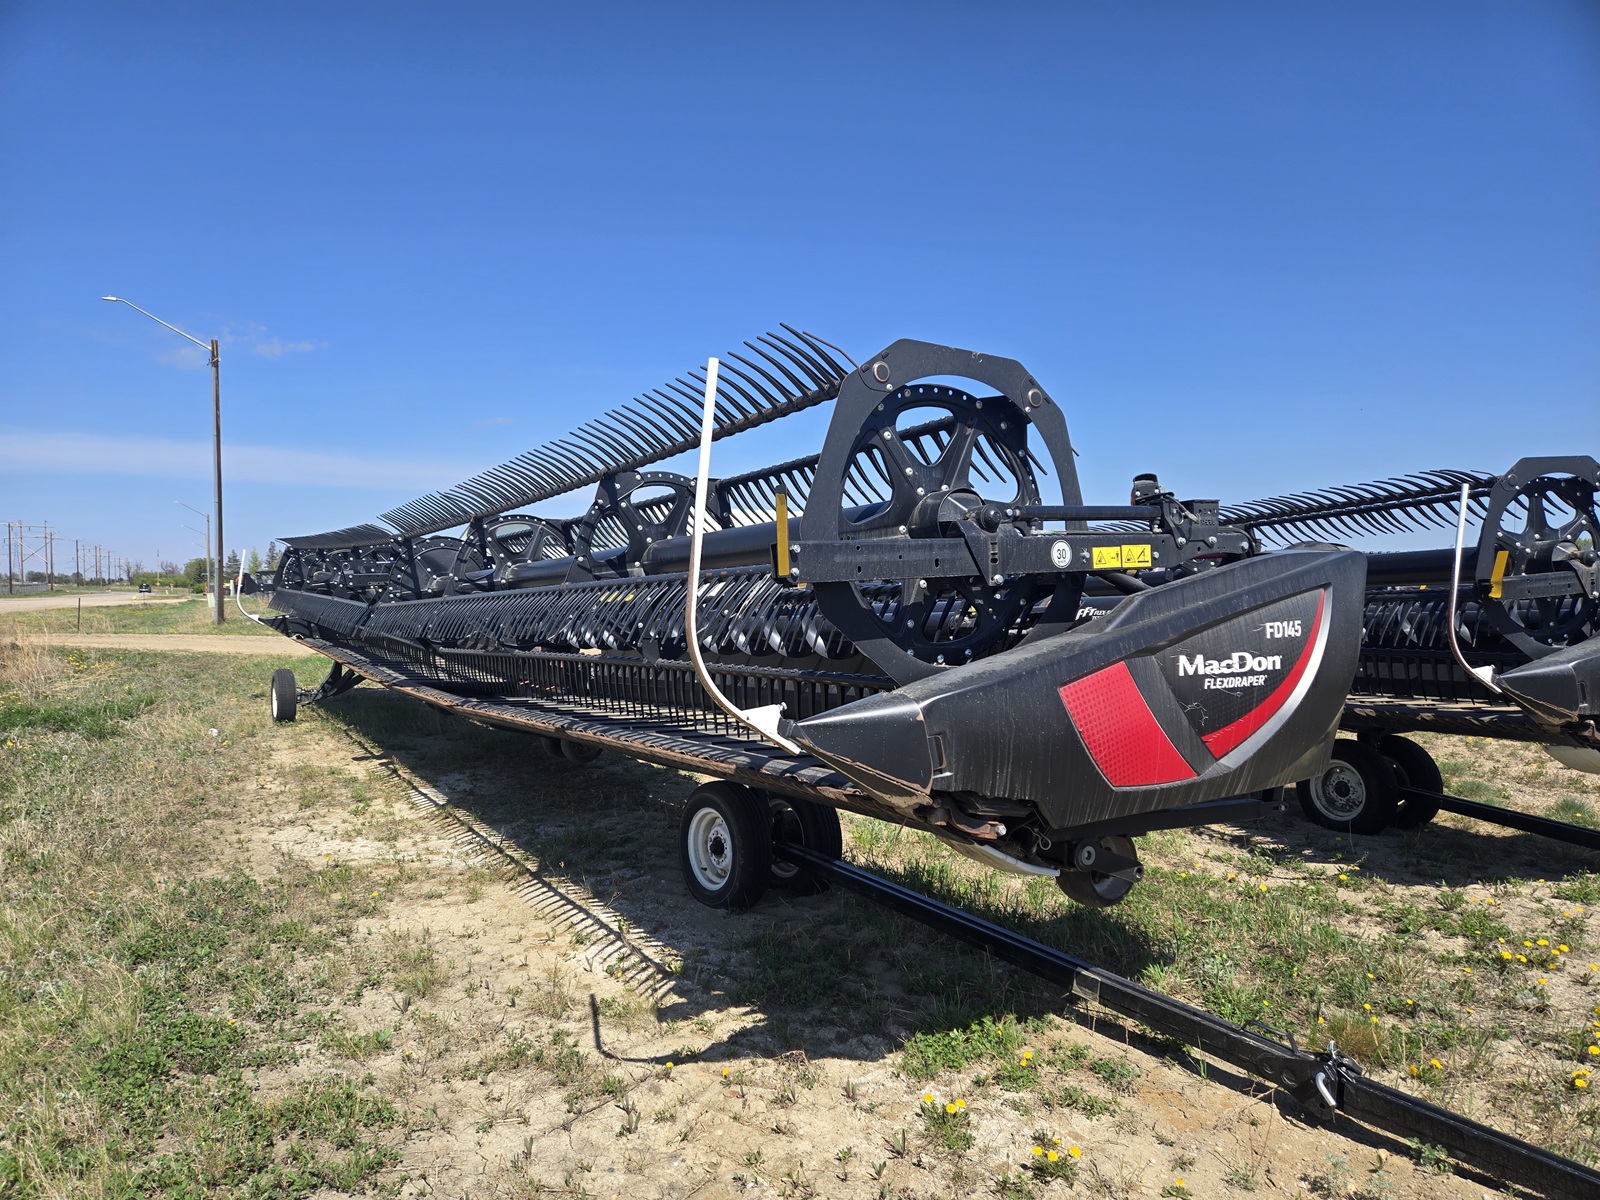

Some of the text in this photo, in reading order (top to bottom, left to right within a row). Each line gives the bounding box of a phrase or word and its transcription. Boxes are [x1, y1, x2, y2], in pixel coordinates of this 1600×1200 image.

[1056, 548, 1067, 560] 30
[1265, 620, 1302, 639] FD145
[1178, 651, 1282, 677] MacDon
[1204, 674, 1266, 690] FLEXDRAPER
